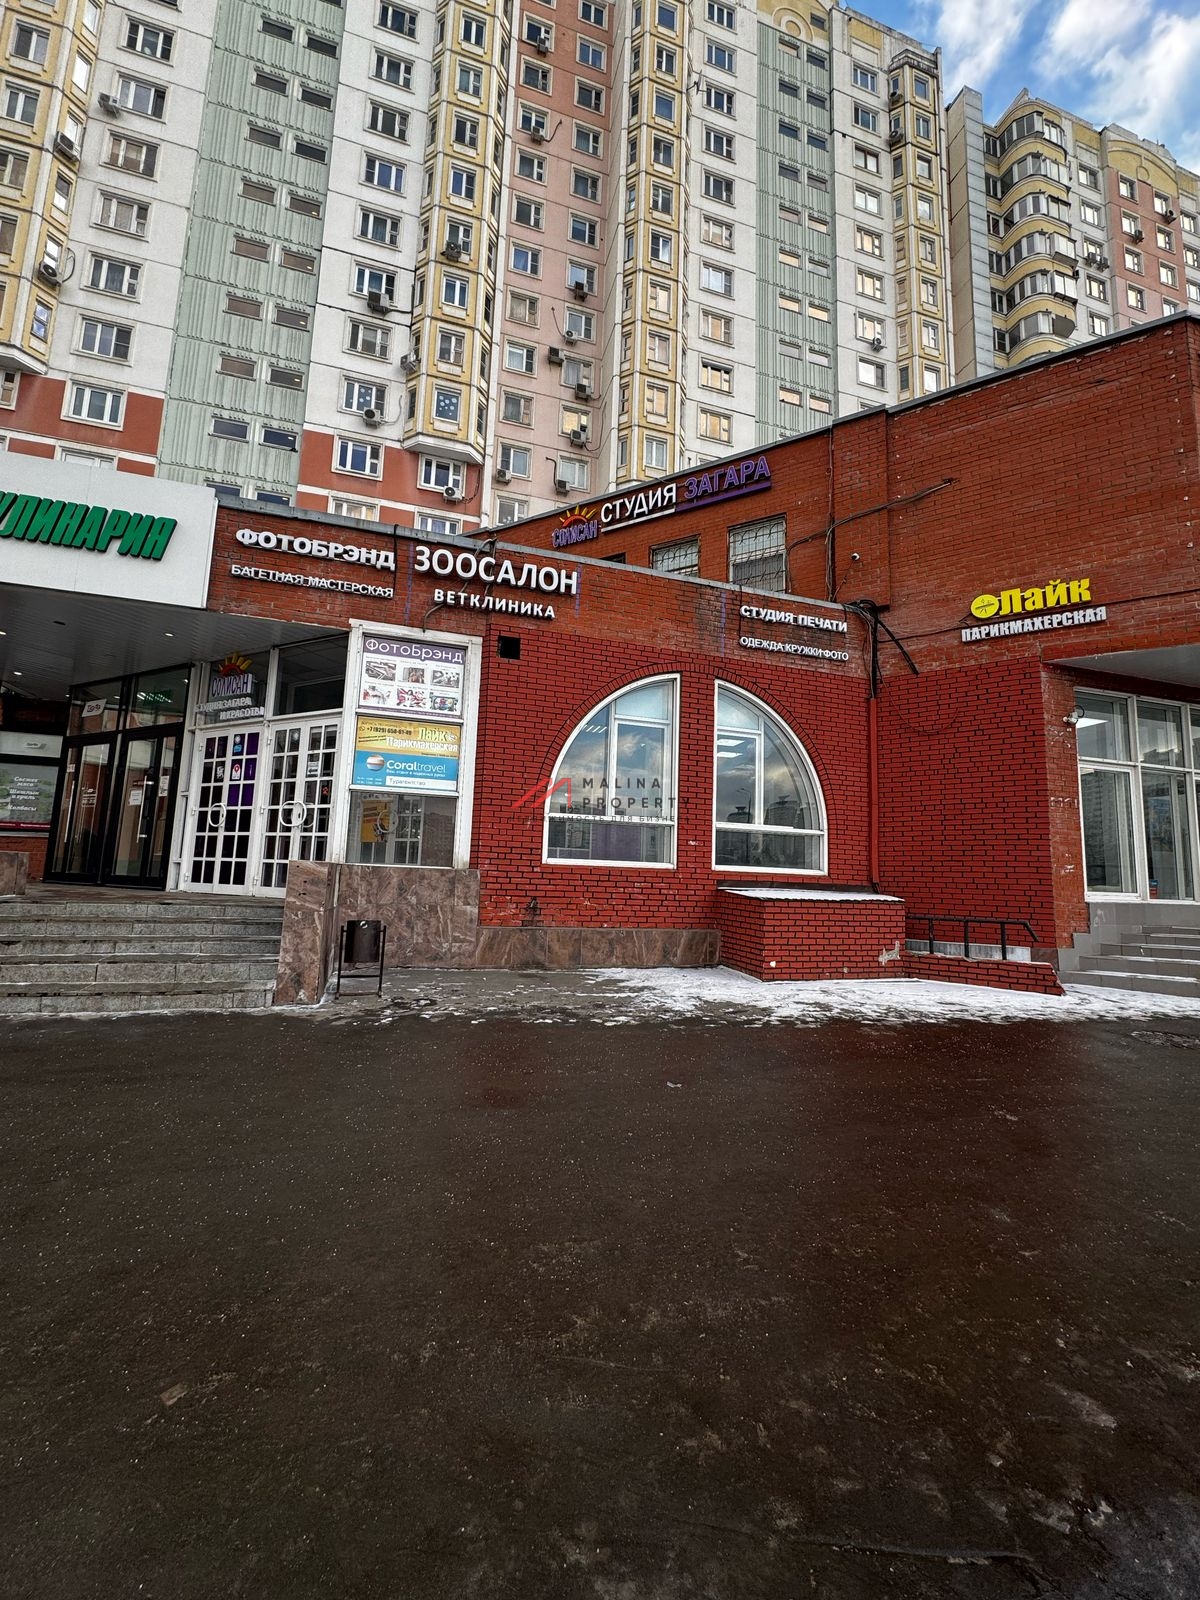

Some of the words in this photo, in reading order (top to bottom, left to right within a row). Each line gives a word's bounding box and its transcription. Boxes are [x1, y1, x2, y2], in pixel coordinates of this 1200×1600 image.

[601, 483, 677, 523] СТУДИЯ
[684, 455, 771, 499] ЗАГАРА
[235, 528, 396, 571] ФОТОБРЭНД
[231, 564, 304, 586] БАГЕТНАЯ
[308, 576, 394, 598] МАСТЕРСКАЯ
[414, 545, 578, 595] ЗООСАЛОН
[433, 588, 556, 619] ВЕТКЛИНИКА
[1000, 578, 1092, 616] Лайк
[740, 605, 794, 623] СТУДИЯ
[797, 614, 848, 633] ПЕЧАТИ
[961, 606, 1107, 642] ПАРИКМАХЕРСКАЯ
[740, 636, 784, 651] ОДЕЖДА
[785, 643, 822, 658] КРУЖКИ
[821, 648, 849, 661] ФОТО
